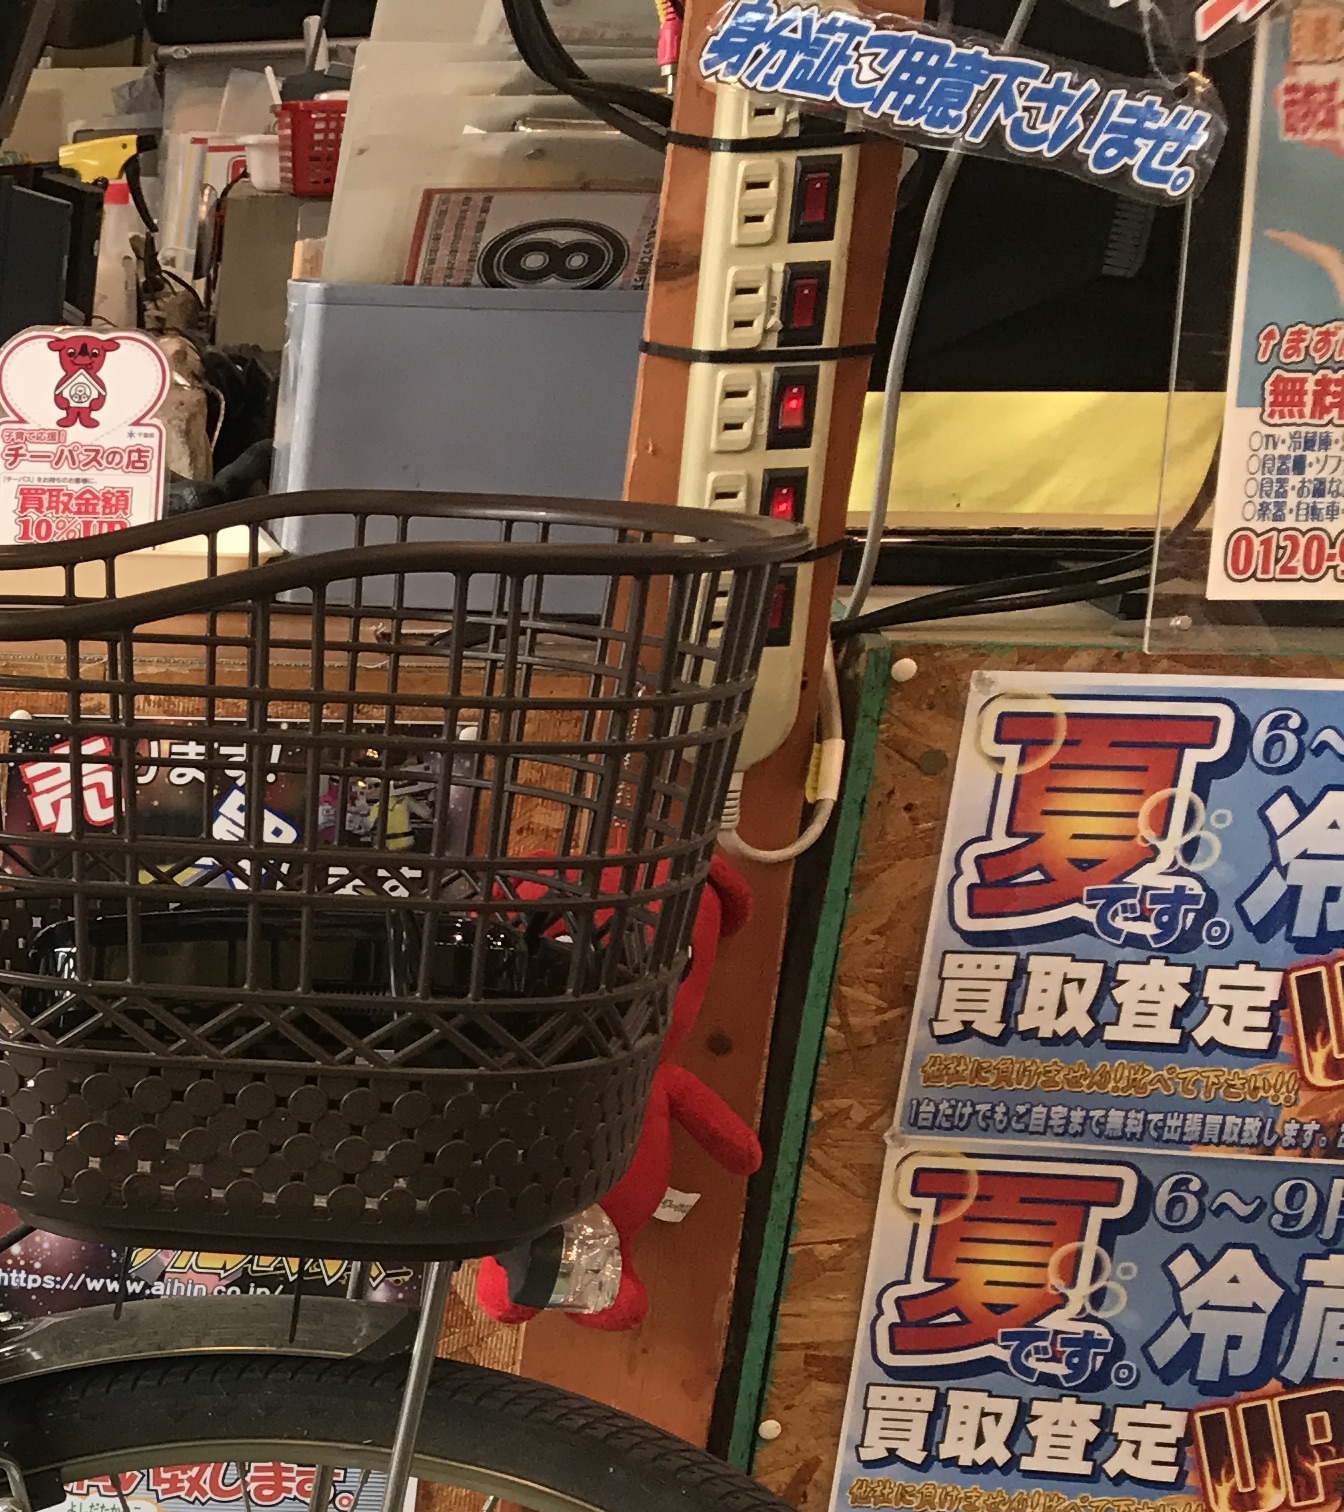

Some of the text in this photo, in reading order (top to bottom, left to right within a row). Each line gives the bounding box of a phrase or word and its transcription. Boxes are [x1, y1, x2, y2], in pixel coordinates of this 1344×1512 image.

[3, 445, 153, 473] チーパスの店
[15, 485, 133, 519] 買取金額
[1229, 532, 1344, 578] 0120-
[967, 710, 1232, 946] 夏 です。
[929, 951, 1288, 1052] 買取査定
[893, 1170, 1123, 1352] 夏
[998, 1329, 1138, 1387] です。
[857, 1385, 1189, 1484] 買取査定
